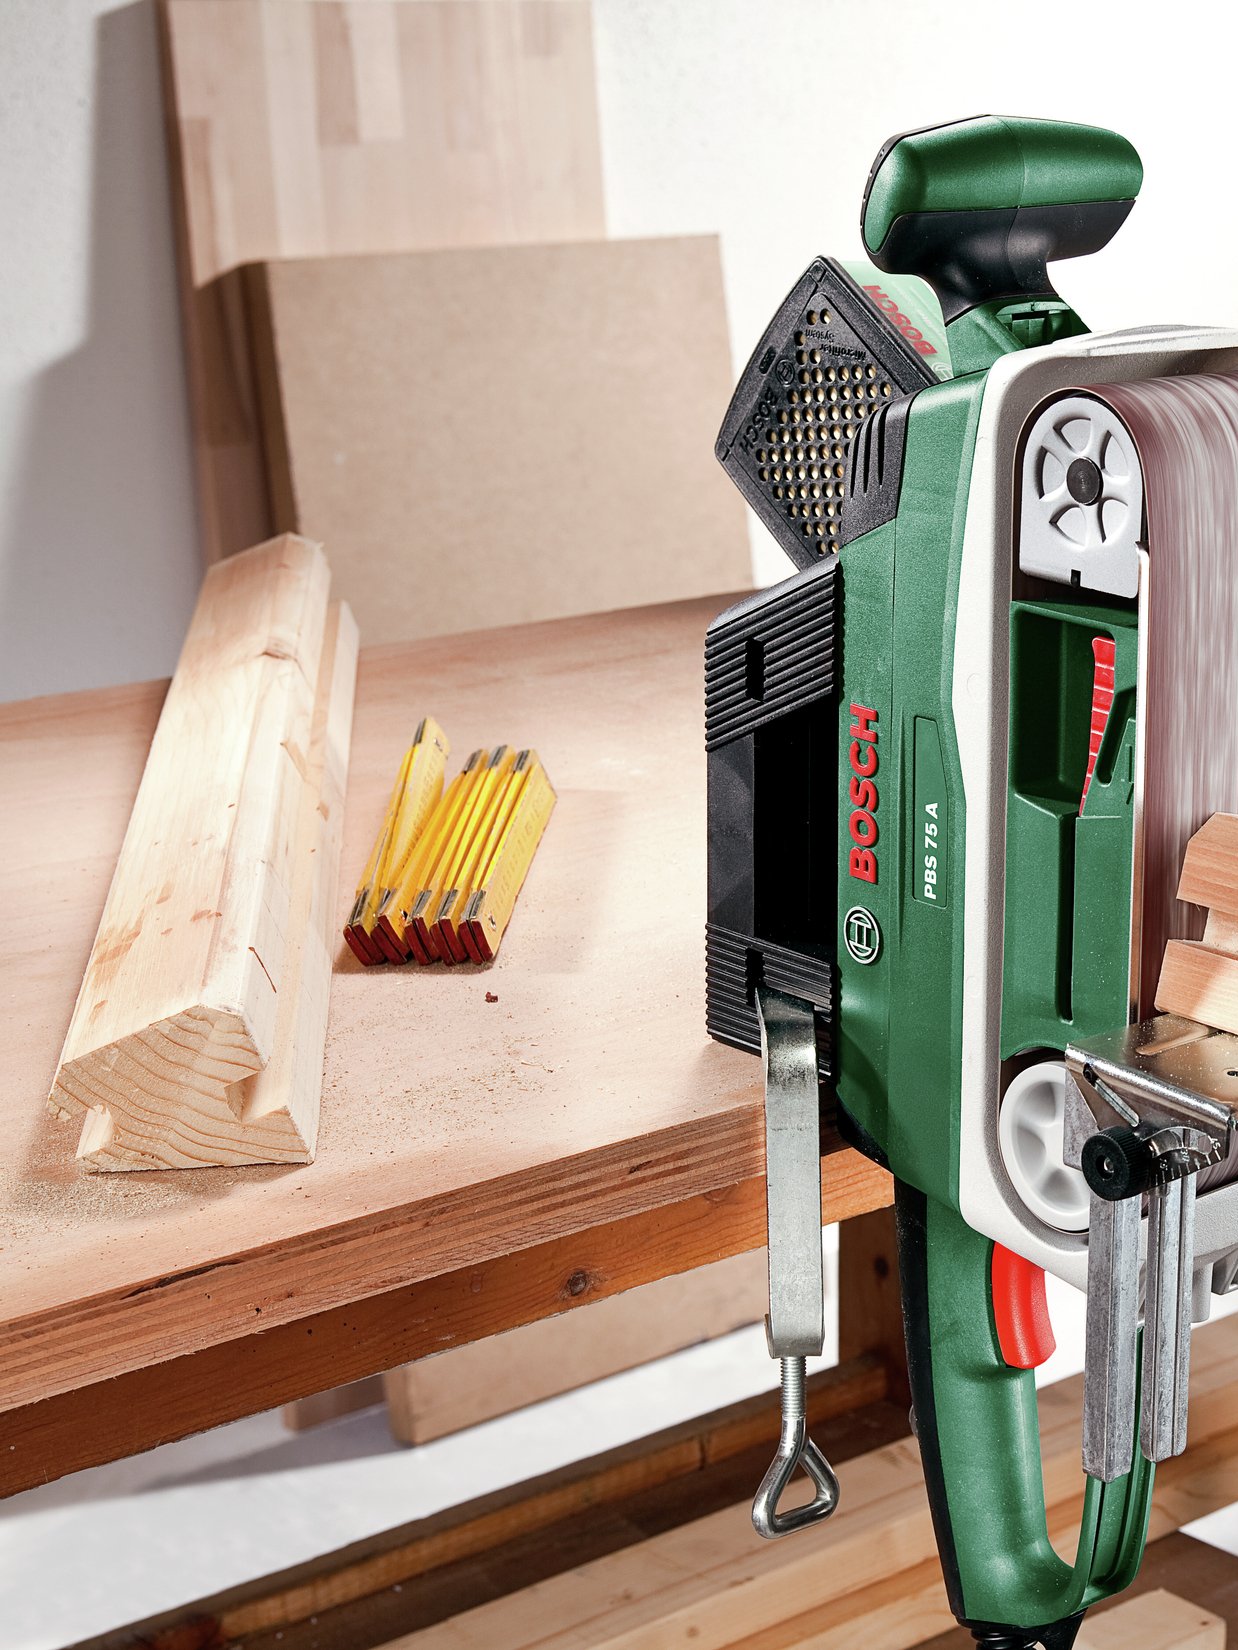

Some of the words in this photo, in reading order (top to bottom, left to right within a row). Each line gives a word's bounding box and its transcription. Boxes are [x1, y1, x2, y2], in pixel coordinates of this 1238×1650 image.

[861, 285, 938, 356] BOSCH
[819, 343, 867, 361] Microfilter
[739, 386, 779, 457] BOSCH
[849, 703, 878, 885] BOSCH
[925, 802, 939, 820] A
[924, 822, 938, 849] 75
[924, 854, 938, 900] PBS
